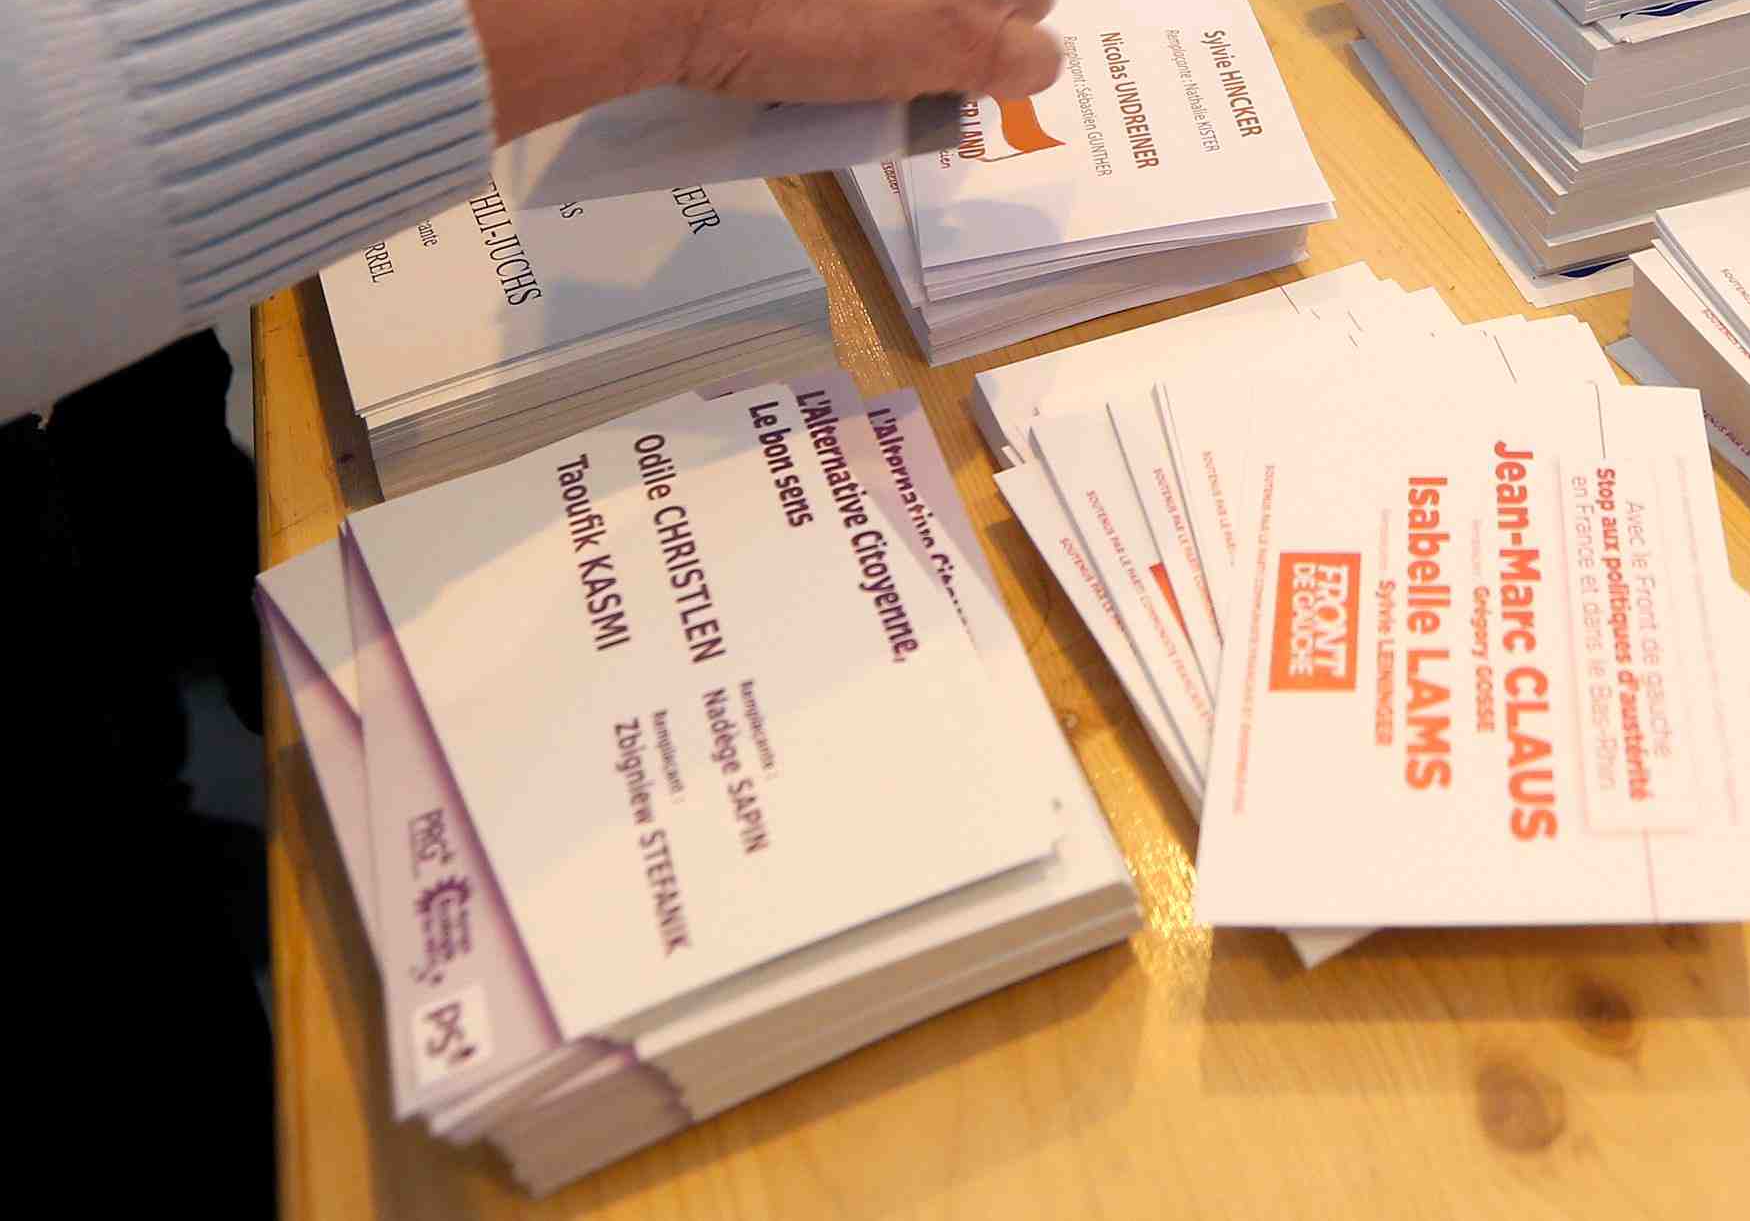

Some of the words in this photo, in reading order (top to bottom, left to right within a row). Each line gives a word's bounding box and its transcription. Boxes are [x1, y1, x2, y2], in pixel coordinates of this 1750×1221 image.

[1100, 32, 1130, 79] Nicolas
[1201, 30, 1236, 68] Sylvie
[1219, 70, 1263, 139] HINCKER
[1075, 87, 1097, 130] Sébastien
[1114, 81, 1159, 169] UNDREINER
[1184, 82, 1206, 121] Nathalie
[1199, 121, 1220, 152] KISTER
[749, 401, 781, 429] Le
[633, 433, 677, 501] Odile
[758, 427, 794, 480] bon
[1571, 475, 1587, 498] en
[557, 453, 607, 552] Taoufik
[775, 477, 815, 528] sens
[1596, 468, 1616, 511] Stop
[1624, 500, 1646, 547] Avec
[796, 389, 868, 529] L'Alternative
[850, 530, 919, 663] Citoyenne,
[1407, 475, 1451, 635] Isabelle
[1494, 440, 1541, 653] Jean-Marc
[1573, 502, 1596, 568] France
[1601, 514, 1620, 551] aux
[578, 554, 631, 651] KASMI
[653, 505, 727, 664] CHRISTLEN
[1291, 562, 1315, 591] DE
[1377, 580, 1396, 635] Sylvie
[1580, 576, 1597, 598] et
[1601, 554, 1632, 666] politiques
[1288, 590, 1314, 676] GAUCHE
[1315, 565, 1349, 678] FRONT
[1582, 602, 1603, 652] dans
[1405, 648, 1452, 792] LAMS
[1474, 663, 1495, 733] GOSSE
[702, 687, 741, 775] Nadège
[727, 779, 769, 856] SAPIN
[1504, 665, 1558, 842] CLAUS
[614, 717, 655, 825] Zbigniew
[639, 829, 691, 958] STEFANIK
[425, 1002, 463, 1057] PS
